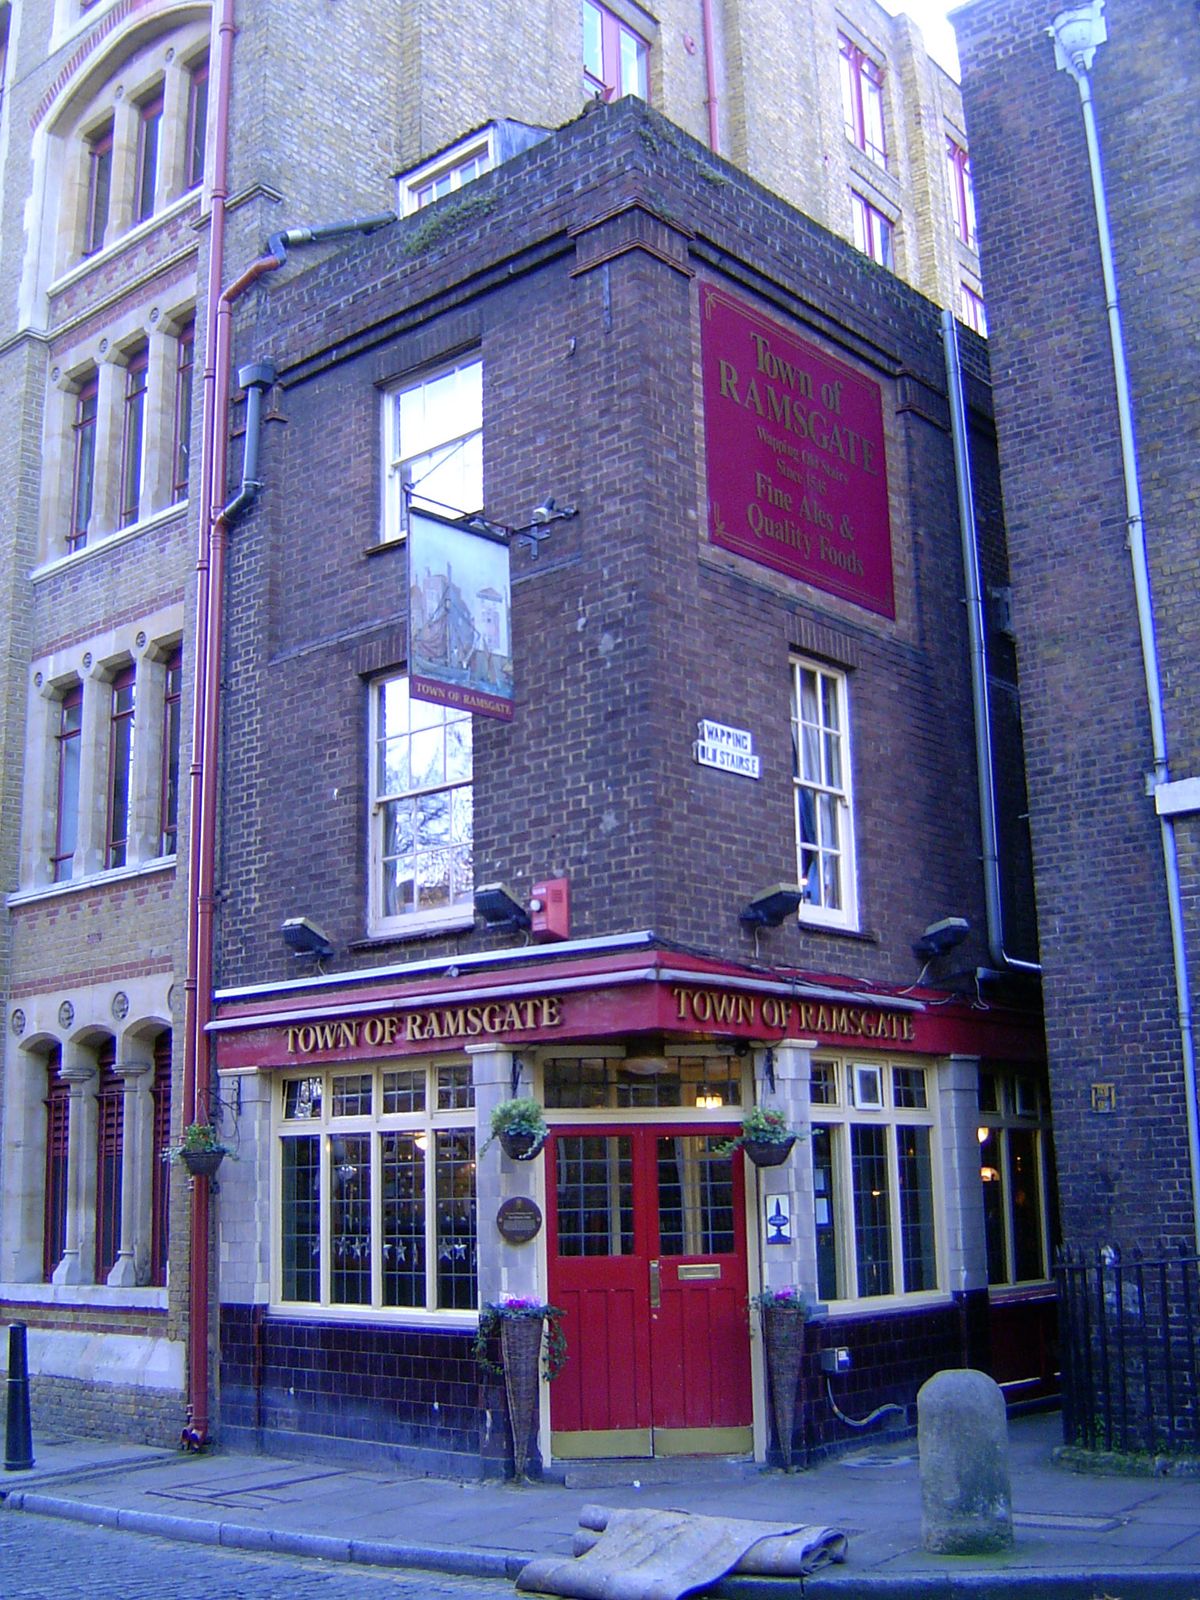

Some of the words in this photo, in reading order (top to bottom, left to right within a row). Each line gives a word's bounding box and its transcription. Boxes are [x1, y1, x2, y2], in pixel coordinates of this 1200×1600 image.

[752, 332, 814, 400] Town
[821, 378, 843, 416] of
[718, 359, 878, 477] RAMSGATE
[756, 424, 800, 465] Wapping
[754, 471, 792, 512] Fine
[800, 494, 834, 532] Ales
[840, 514, 856, 542] &
[746, 503, 813, 561] Quality
[819, 536, 865, 578] Foods
[415, 682, 446, 699] TOWN
[448, 690, 460, 702] OF
[463, 694, 512, 715] RAMSGATE
[706, 724, 748, 750] WAPPING
[719, 750, 750, 772] STAIRS
[283, 1022, 359, 1054] TOWN
[364, 1016, 400, 1045] OF
[405, 998, 562, 1042] RAMSGATE
[674, 987, 754, 1025] TOWN
[762, 997, 793, 1028] OF
[799, 1000, 916, 1041] RAMSGATE
